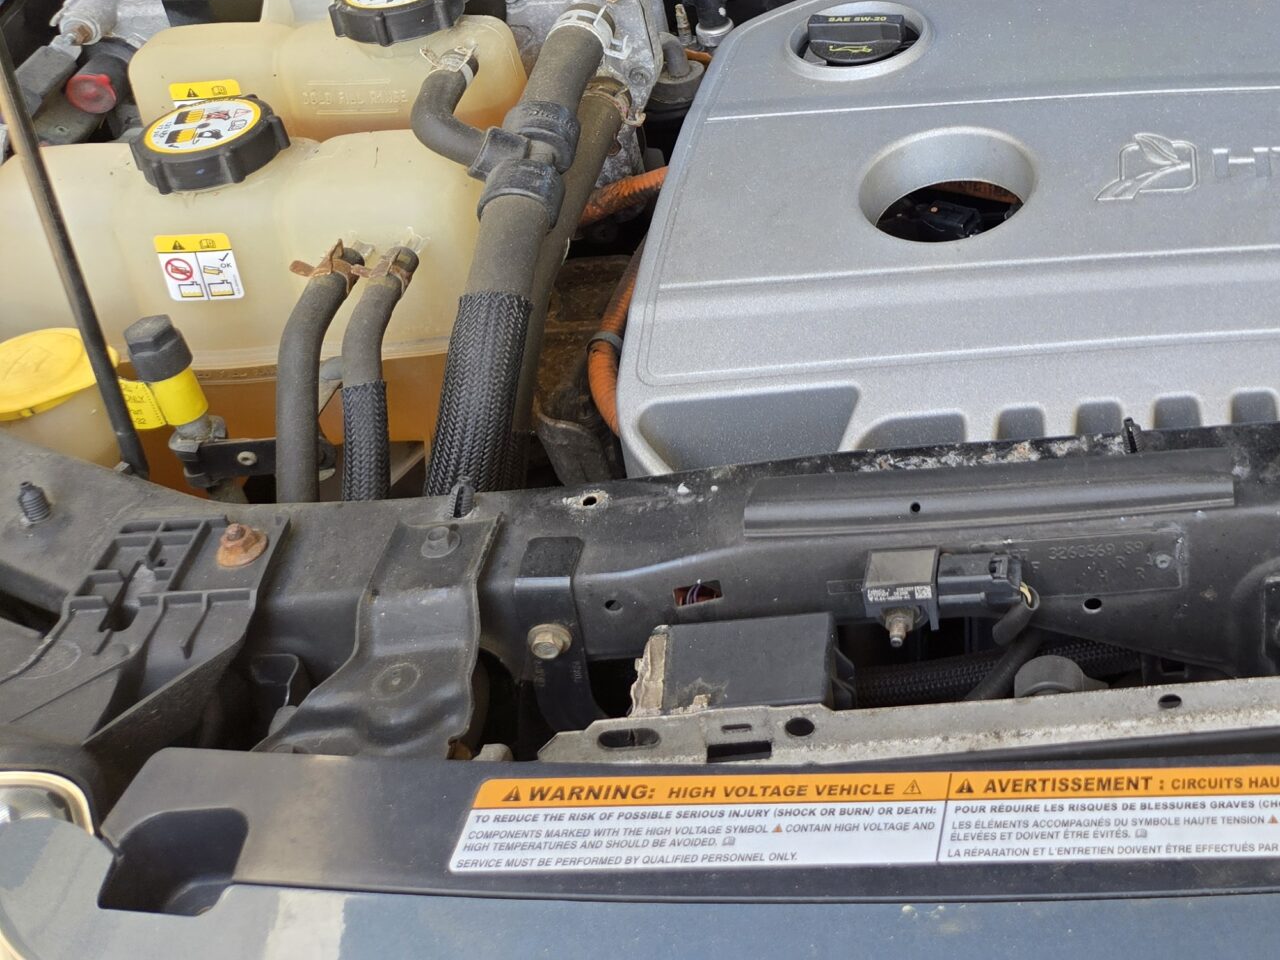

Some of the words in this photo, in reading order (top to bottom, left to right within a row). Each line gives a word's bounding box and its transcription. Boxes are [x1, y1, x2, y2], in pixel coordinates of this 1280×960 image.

[528, 784, 656, 802] WARNING:
[667, 786, 716, 800] HIGH
[722, 784, 808, 798] VOLTAGE
[814, 783, 896, 796] VEHICLE
[983, 776, 1153, 793] AVERTISSEMENT
[1171, 776, 1244, 790] CIRCUITS
[475, 815, 490, 824] TO
[494, 814, 540, 823] REDUCE
[543, 813, 565, 822] THE
[569, 812, 596, 822] RISK
[599, 812, 614, 821] OF
[617, 810, 672, 820] POSSIBLE
[676, 810, 726, 819] SERIOUS
[728, 808, 770, 818] INJURY
[773, 808, 816, 818] (SHOCK
[820, 808, 836, 816] OR
[839, 806, 874, 816] BURN)
[878, 806, 894, 816] OR
[896, 806, 937, 815] DEATH:
[954, 804, 986, 814] POUR
[990, 803, 1040, 813] RÉDUIRE
[1044, 804, 1064, 812] LES
[1068, 802, 1118, 812] RISQUES
[1121, 802, 1136, 810] DE
[1140, 800, 1206, 810] BLESSURES
[1210, 800, 1255, 810] GRAVES
[952, 820, 972, 830] LES
[974, 818, 1030, 829] ÉLÉMENTS
[1032, 816, 1112, 828] ACCOMPAGNÉS
[1114, 818, 1128, 827] DU
[1130, 816, 1180, 826] SYMBOLE
[1184, 816, 1218, 826] HAUTE
[1221, 815, 1265, 824] TENSION
[468, 830, 542, 840] COMPONENTS
[544, 828, 589, 838] MARKED
[593, 828, 620, 837] WITH
[622, 828, 642, 836] THE
[645, 826, 672, 836] HIGH
[674, 826, 723, 835] VOLTAGE
[725, 824, 769, 834] SYMBOL
[785, 823, 831, 833] CONTAIN
[834, 822, 860, 832] HIGH
[862, 822, 910, 832] VOLTAGE
[912, 822, 936, 830] AND
[950, 830, 997, 842] ÉLEVÉES
[1000, 832, 1013, 840] ET
[1016, 830, 1060, 840] DOIVENT
[1063, 828, 1090, 839] ÊTRE
[1092, 828, 1132, 839] ÉVITÉS.
[463, 842, 489, 852] HIGH
[492, 840, 578, 851] TEMPERATURES
[580, 840, 602, 850] AND
[606, 839, 650, 848] SHOULD
[652, 838, 667, 848] BE
[668, 838, 718, 848] AVOIDED.
[948, 848, 961, 858] LA
[963, 846, 1030, 857] RÉPARATION
[1033, 846, 1046, 856] ET
[1048, 845, 1115, 856] L'ENTRETIEN
[1117, 844, 1162, 854] DOIVENT
[1166, 842, 1192, 854] ÊTRE
[1195, 842, 1256, 854] EFFECTUÉS
[1258, 842, 1279, 852] PAR
[456, 858, 502, 868] SERVICE
[504, 858, 535, 868] MUST
[536, 858, 553, 866] BE
[554, 856, 624, 866] PERFORMED
[626, 856, 640, 864] BY
[642, 854, 698, 864] QUALIFIED
[701, 852, 765, 863] PERSONNEL
[768, 852, 798, 862] ONLY.
